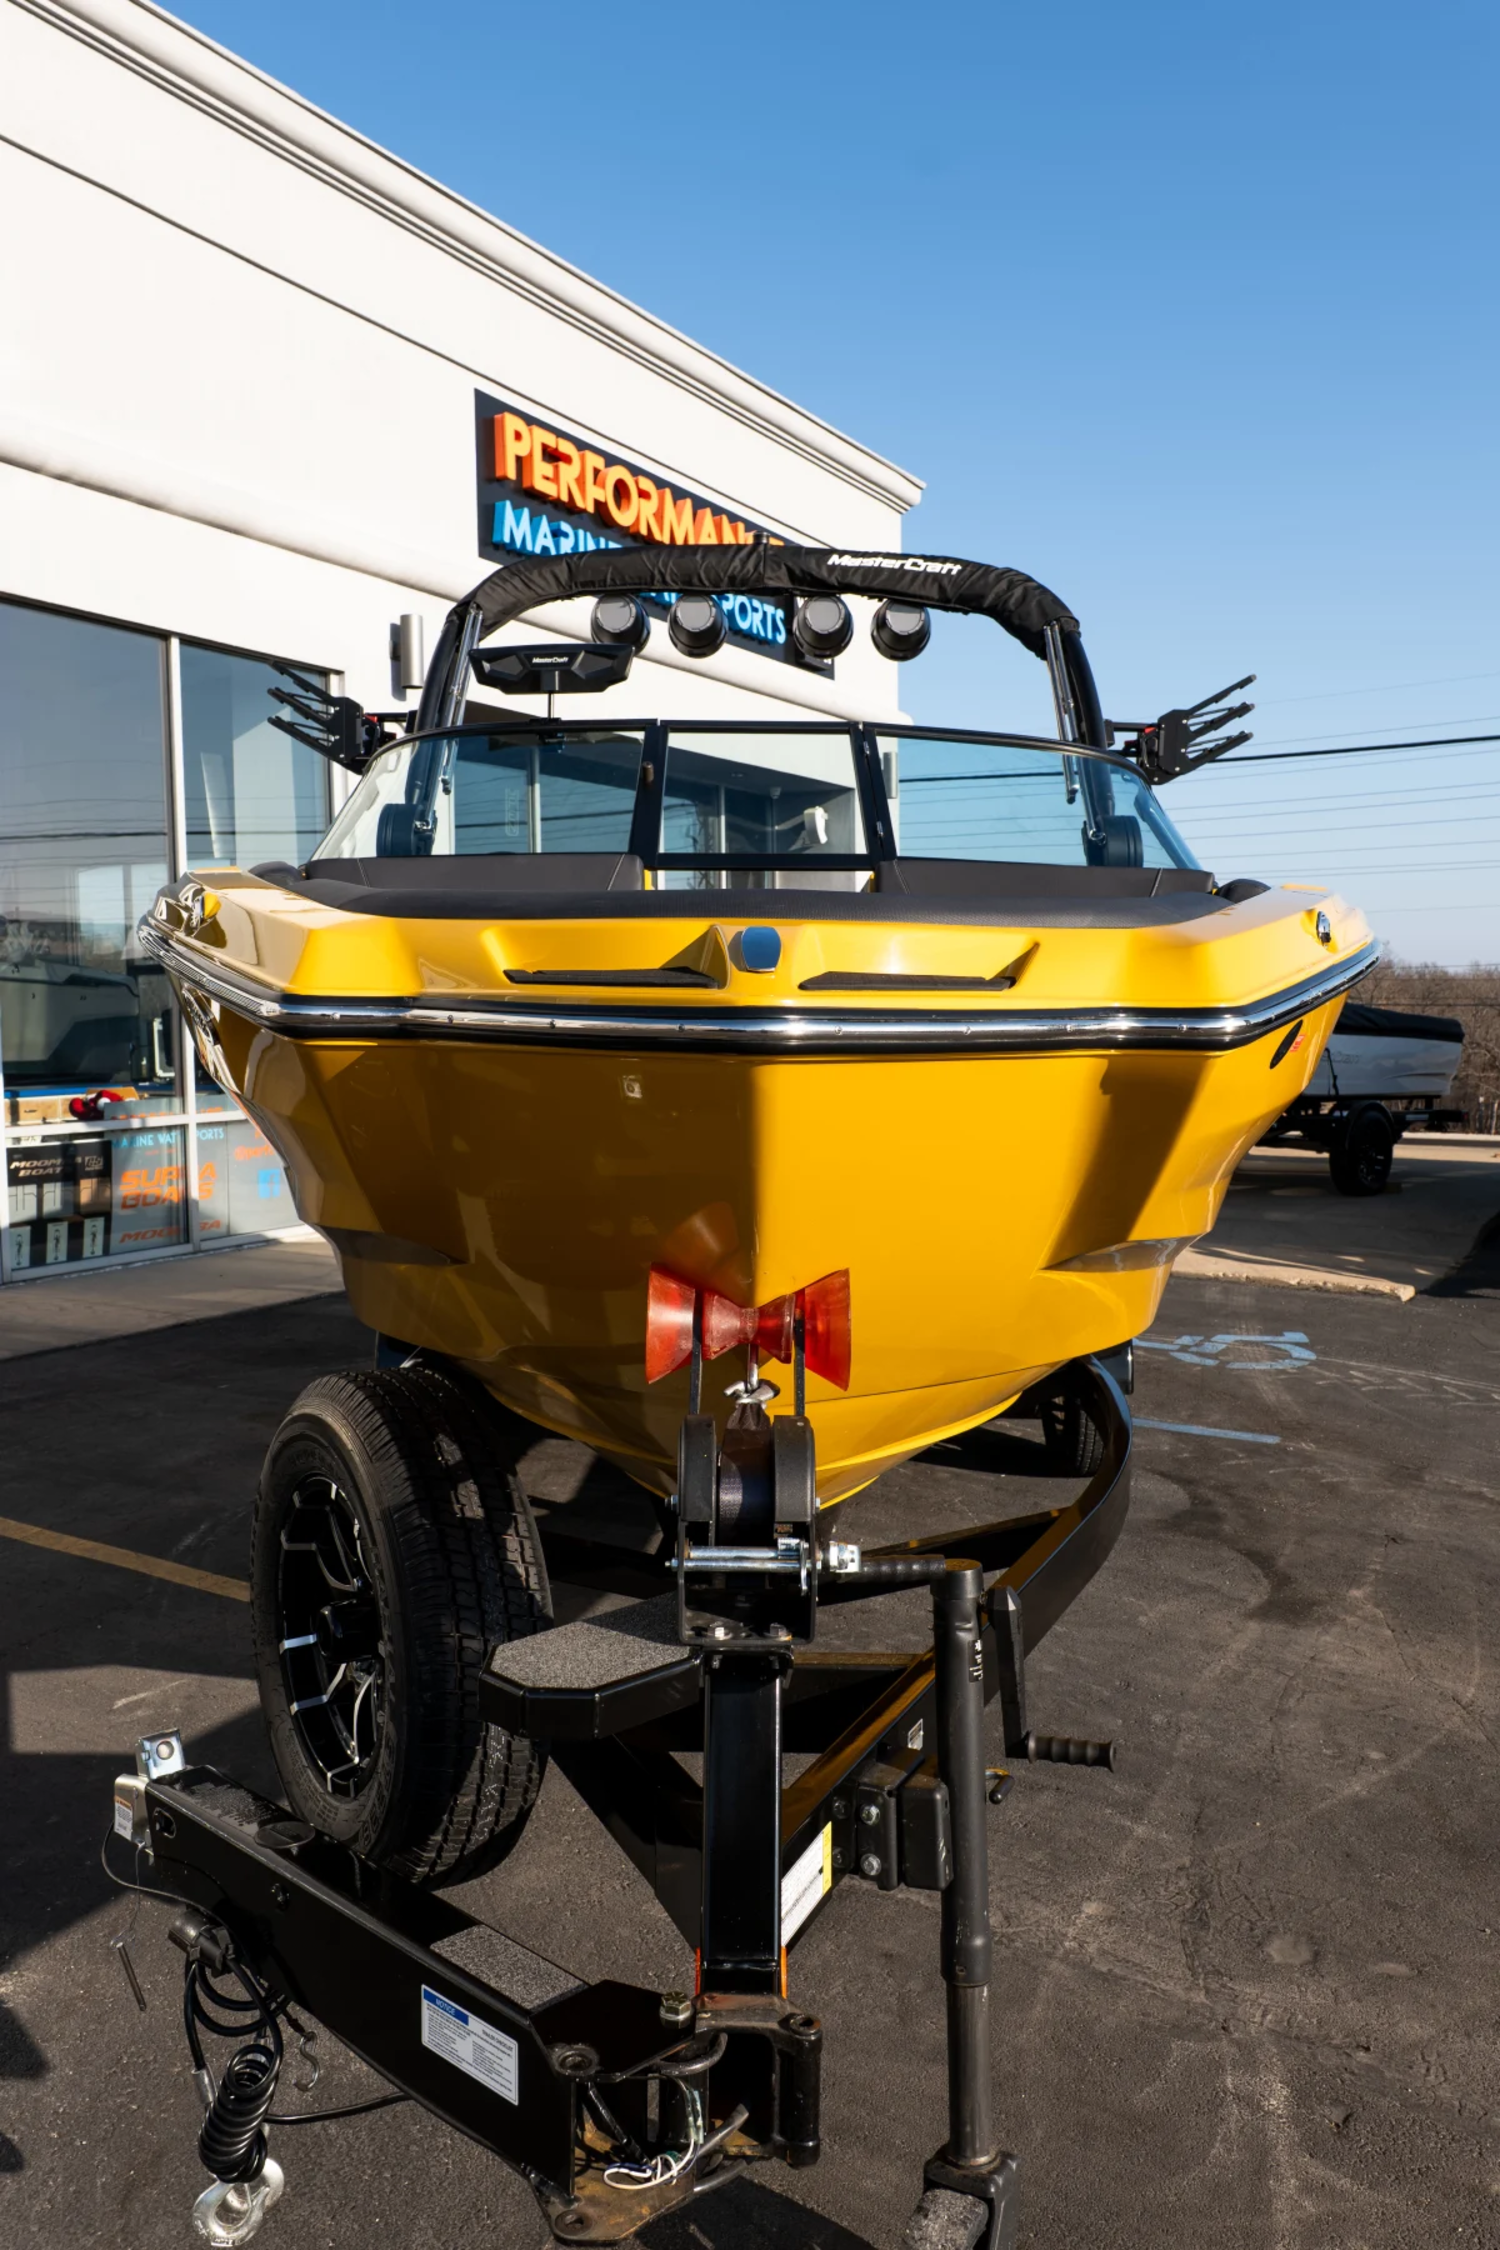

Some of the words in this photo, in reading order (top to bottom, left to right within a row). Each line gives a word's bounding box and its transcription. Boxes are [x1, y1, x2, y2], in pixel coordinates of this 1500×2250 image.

[494, 411, 784, 546] PERFORMAN
[827, 554, 962, 575] MasterCraft
[711, 593, 787, 645] PORTS
[157, 1130, 180, 1145] WAT
[195, 1127, 225, 1141] PORTS
[18, 1166, 63, 1177] BOAT
[119, 1161, 218, 1191] SUPA
[120, 1180, 215, 1210] BOAS
[119, 1219, 222, 1244] MOOBA
[435, 1998, 456, 2016] NOTICE
